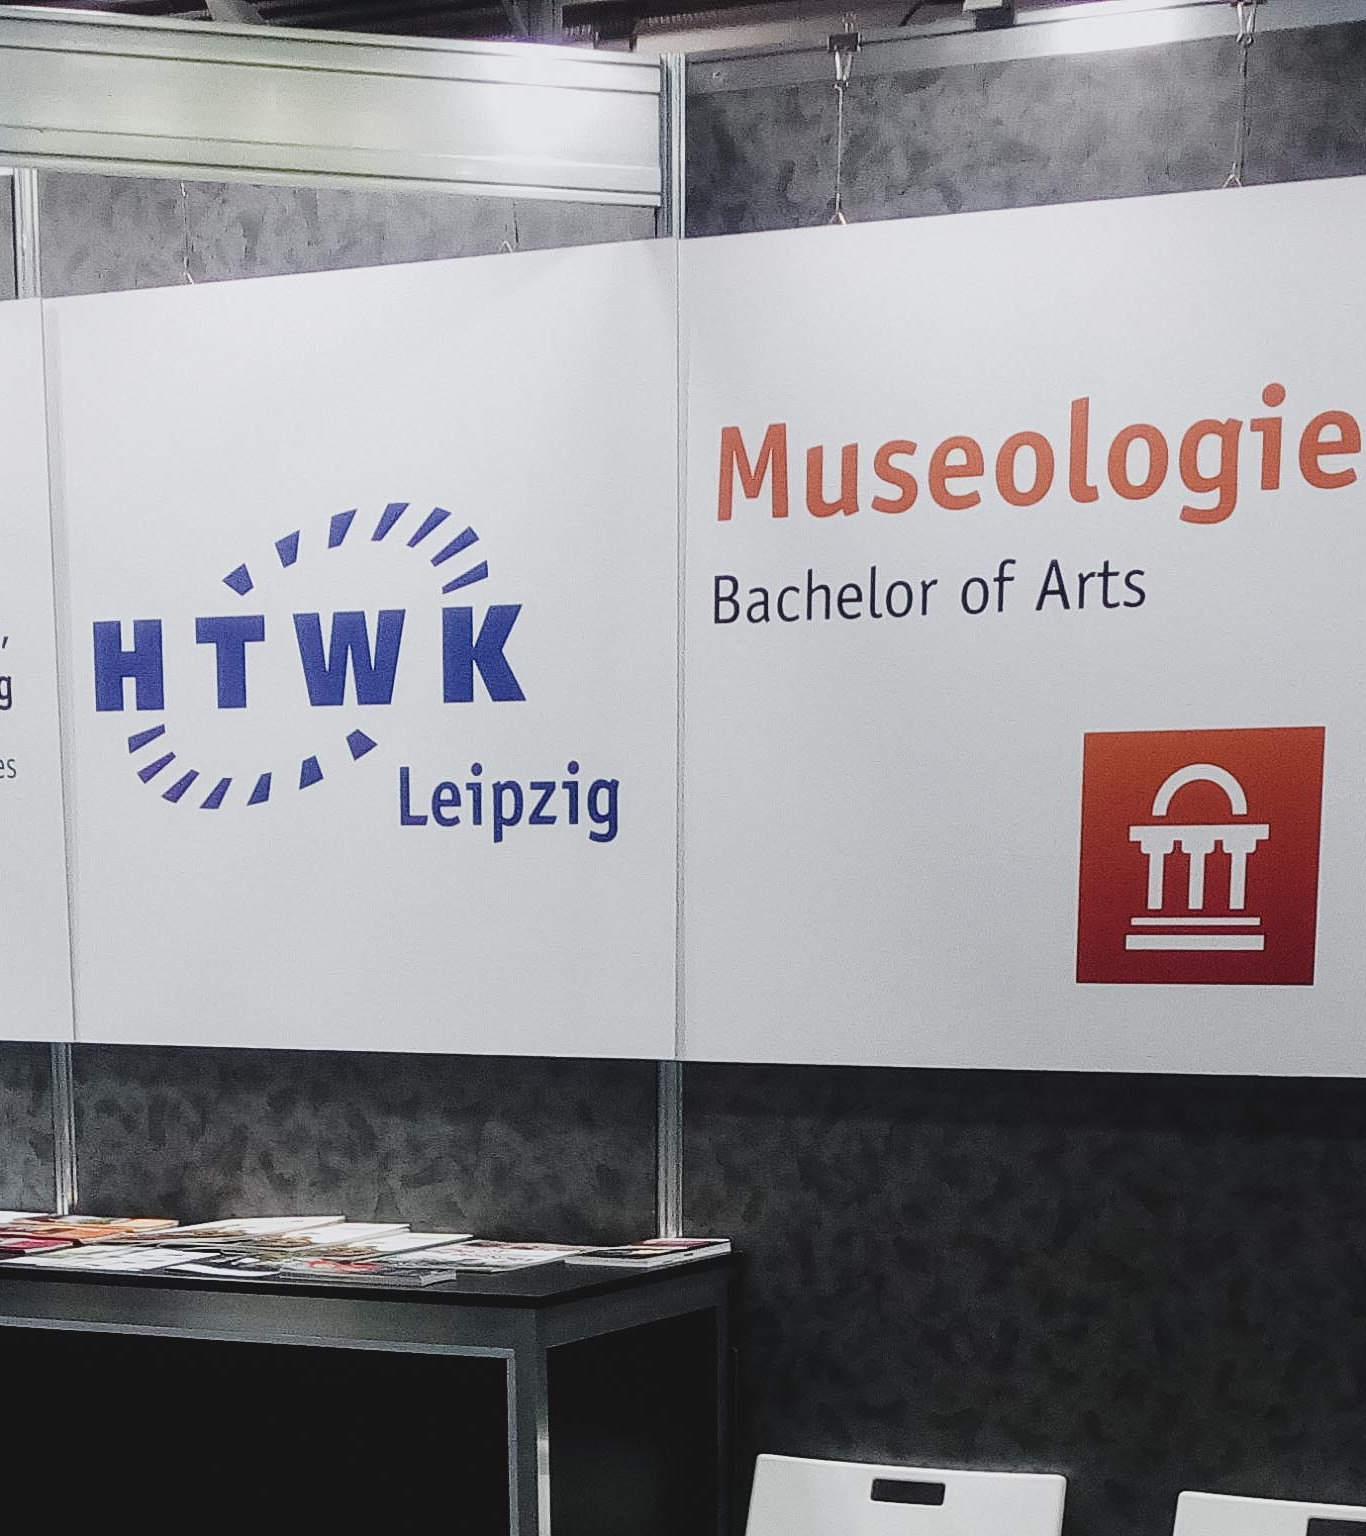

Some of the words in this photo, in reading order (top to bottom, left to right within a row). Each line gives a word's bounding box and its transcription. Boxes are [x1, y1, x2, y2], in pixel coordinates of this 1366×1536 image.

[717, 383, 1362, 525] Museologie
[713, 566, 937, 624] Bachelor
[961, 559, 1016, 614] of
[1035, 559, 1146, 611] Arts
[92, 604, 526, 712] HTWK
[400, 761, 619, 843] Leipzig
